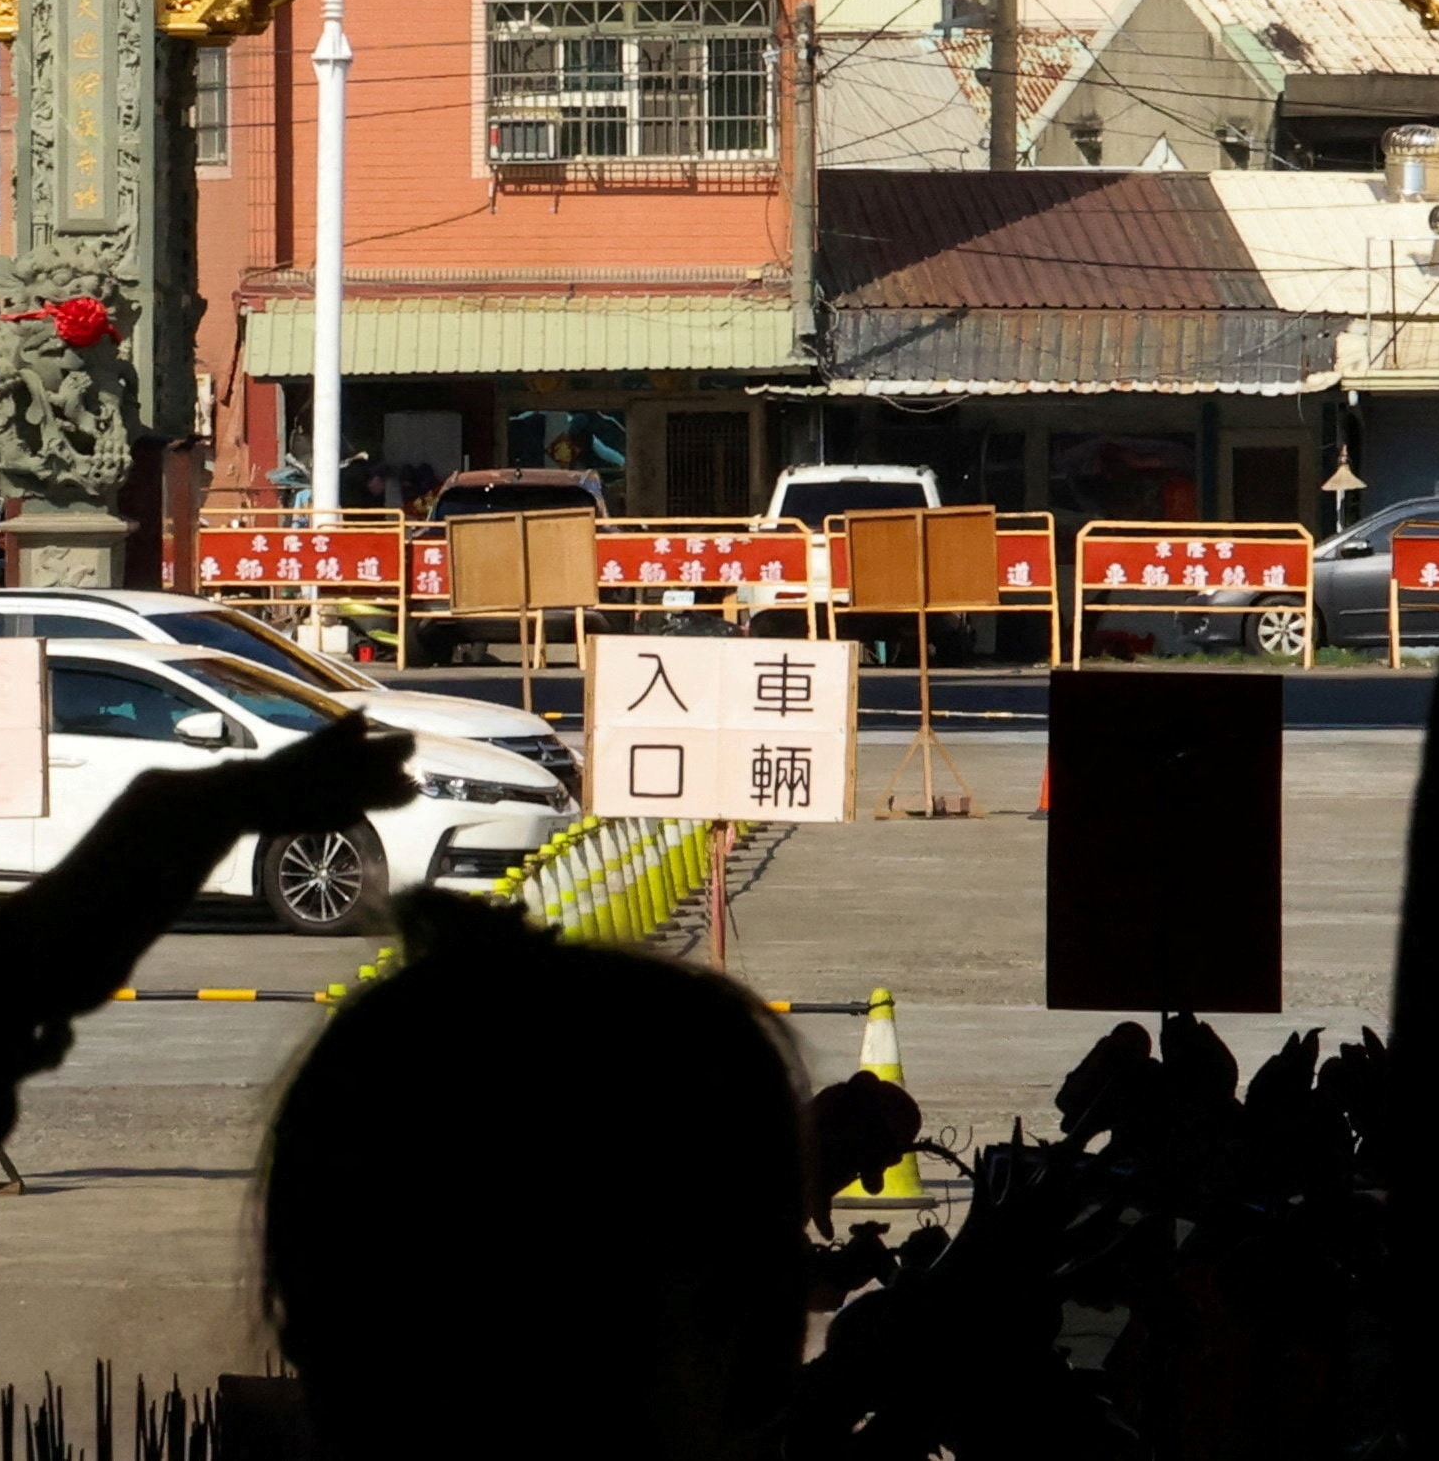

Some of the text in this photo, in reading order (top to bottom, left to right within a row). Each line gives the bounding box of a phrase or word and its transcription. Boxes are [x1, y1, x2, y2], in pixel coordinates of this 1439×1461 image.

[251, 534, 330, 553] 東隆宮
[653, 537, 734, 555] 東隆宮
[1154, 541, 1234, 558] 東隆宮
[199, 556, 382, 582] 車輛請繞道
[600, 559, 786, 583] 車輛請繞道
[1007, 561, 1033, 586] 道
[1103, 563, 1287, 588] 車輛請繞道
[626, 652, 690, 799] 入口
[749, 652, 817, 808] 車輛
